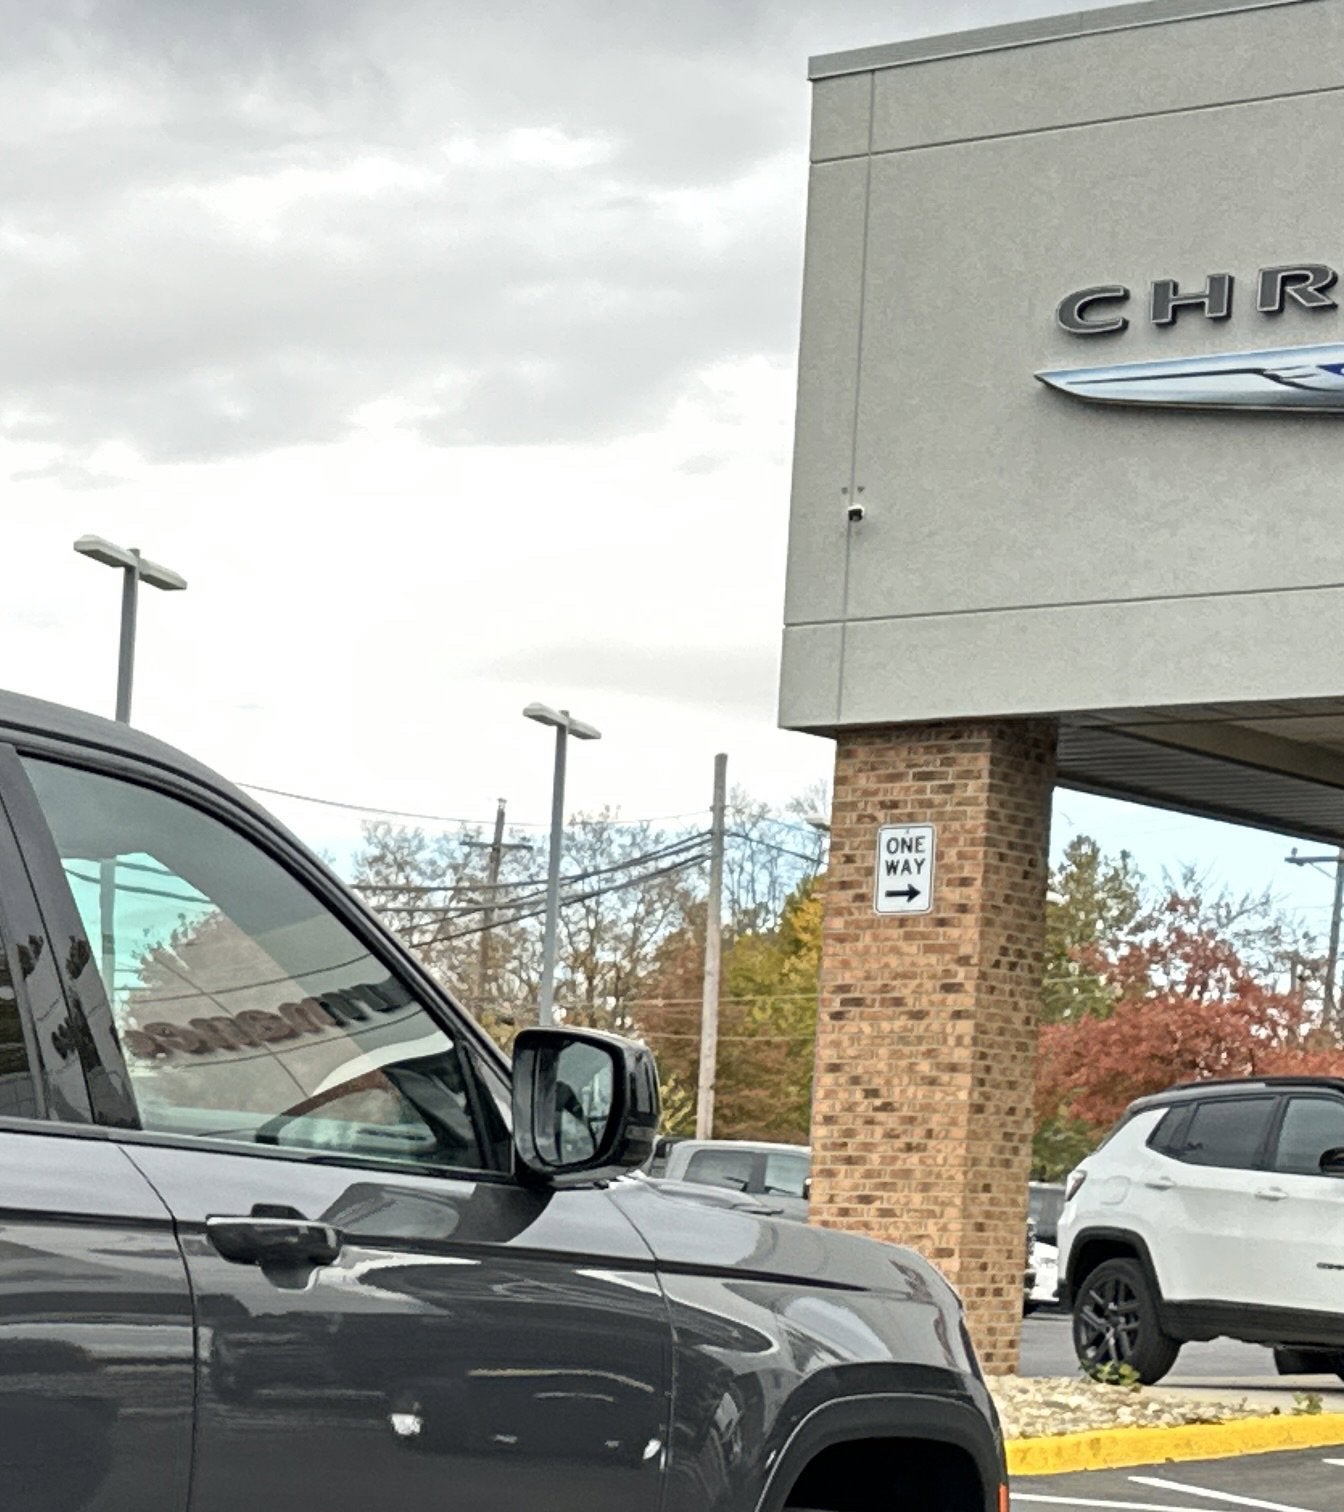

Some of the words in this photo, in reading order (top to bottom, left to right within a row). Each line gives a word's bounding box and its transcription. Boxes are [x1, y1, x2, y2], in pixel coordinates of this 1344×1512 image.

[1055, 263, 1339, 335] CHR
[886, 835, 926, 855] ONE
[885, 858, 926, 876] WAY
